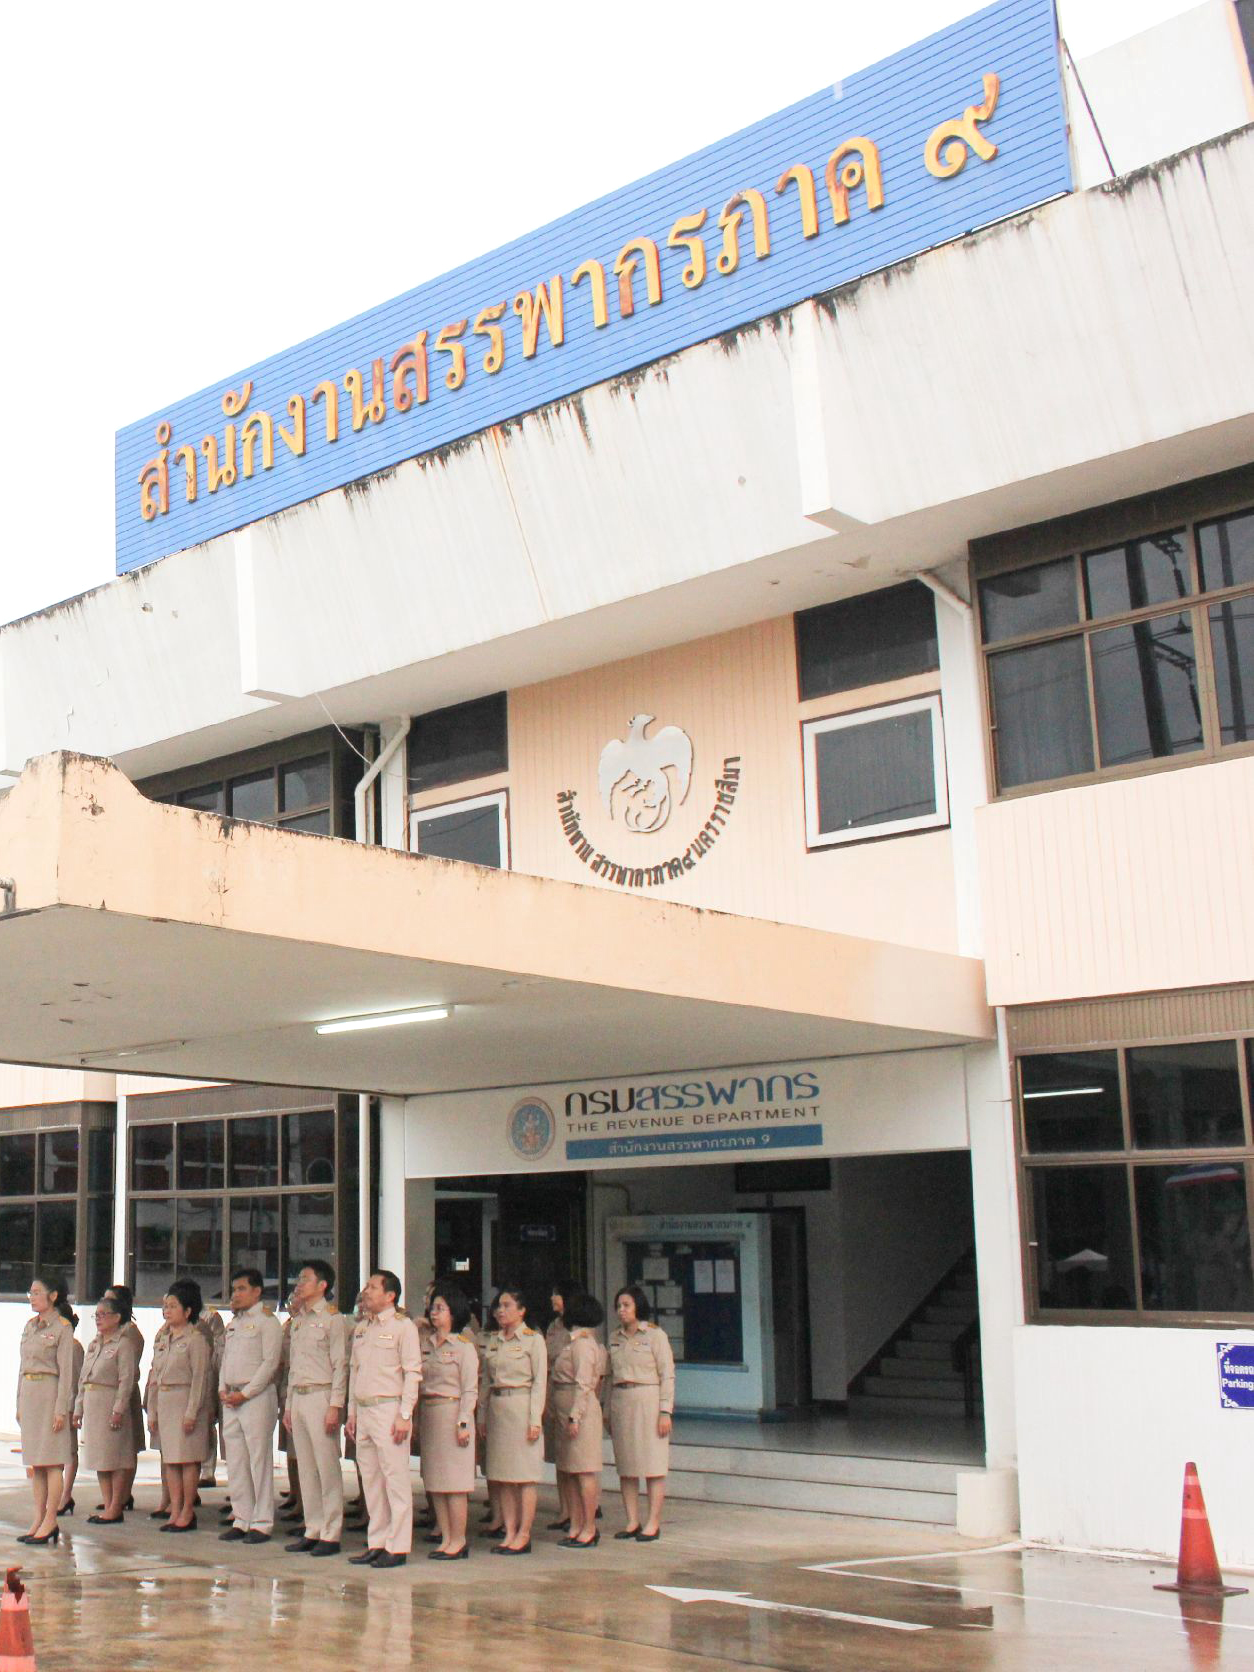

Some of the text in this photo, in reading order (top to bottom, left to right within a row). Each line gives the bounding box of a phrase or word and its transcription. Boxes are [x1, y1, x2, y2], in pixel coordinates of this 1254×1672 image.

[138, 72, 1002, 521] สำนักงานสรรพากรภาค ๙
[564, 1071, 821, 1118] กรมสรรพากร
[566, 1105, 821, 1133] THE REVENUE DEPARTMENT
[608, 1133, 771, 1155] สำนักงานสรรพากรภาค 9
[1221, 1377, 1254, 1391] Parking
